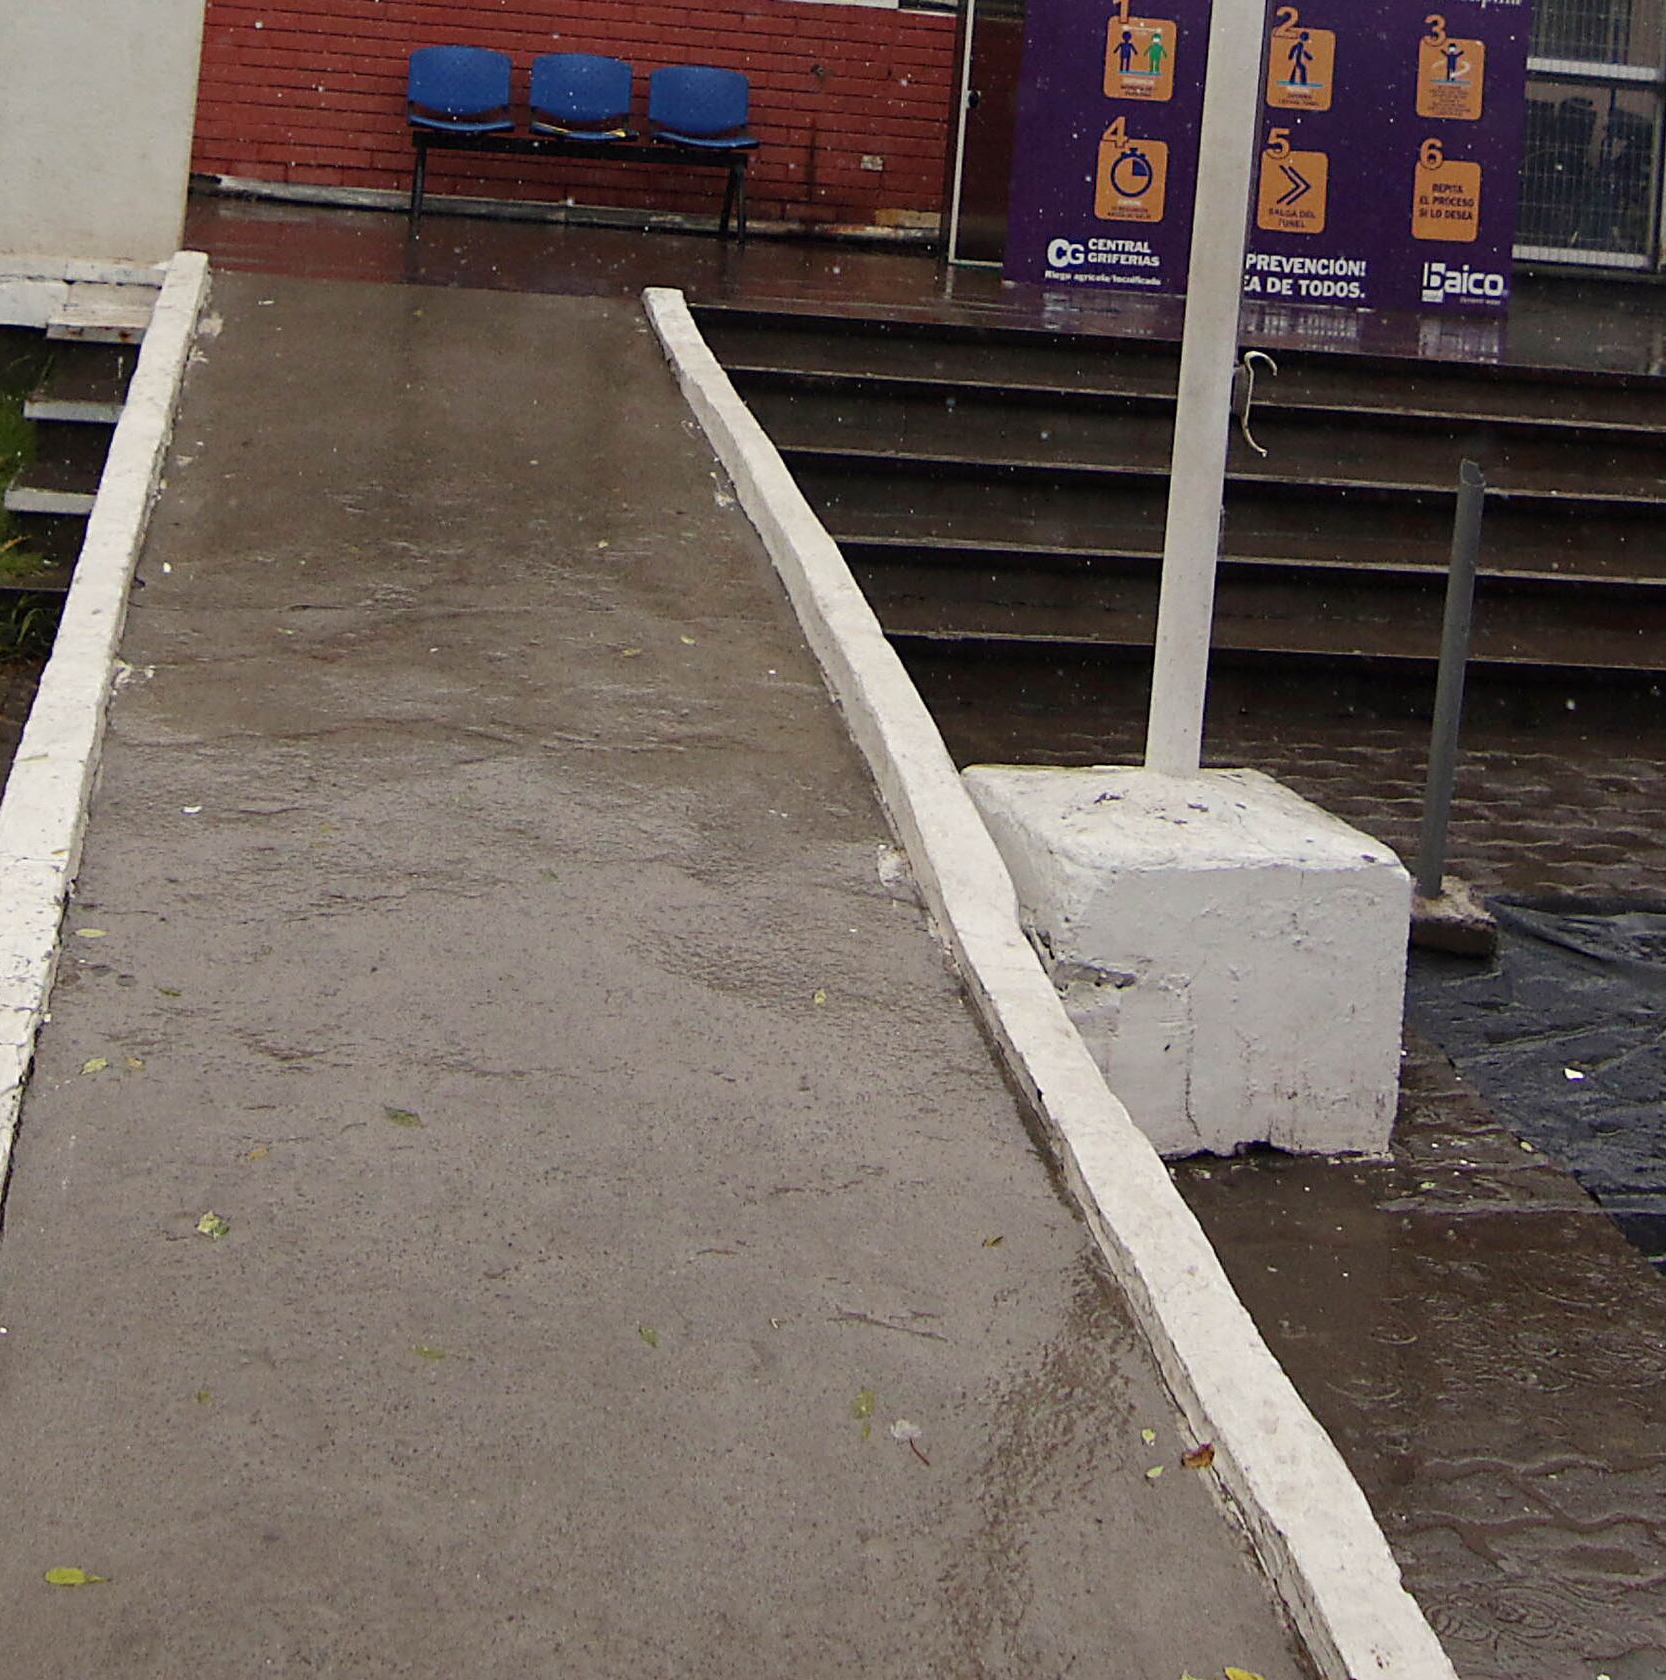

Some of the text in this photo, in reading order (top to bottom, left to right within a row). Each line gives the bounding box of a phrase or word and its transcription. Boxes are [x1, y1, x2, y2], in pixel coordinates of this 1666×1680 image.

[1275, 5, 1299, 39] 2
[1423, 13, 1447, 48] 3
[1101, 115, 1130, 149] 4
[1266, 127, 1291, 160] 5
[1420, 138, 1444, 170] 6
[1087, 252, 1161, 267] GRIFERIAS
[1088, 238, 1152, 254] CENTRAL
[1245, 253, 1367, 277] PREVENCIÓN!
[1266, 276, 1293, 296] DE
[1297, 279, 1366, 299] TODOS.
